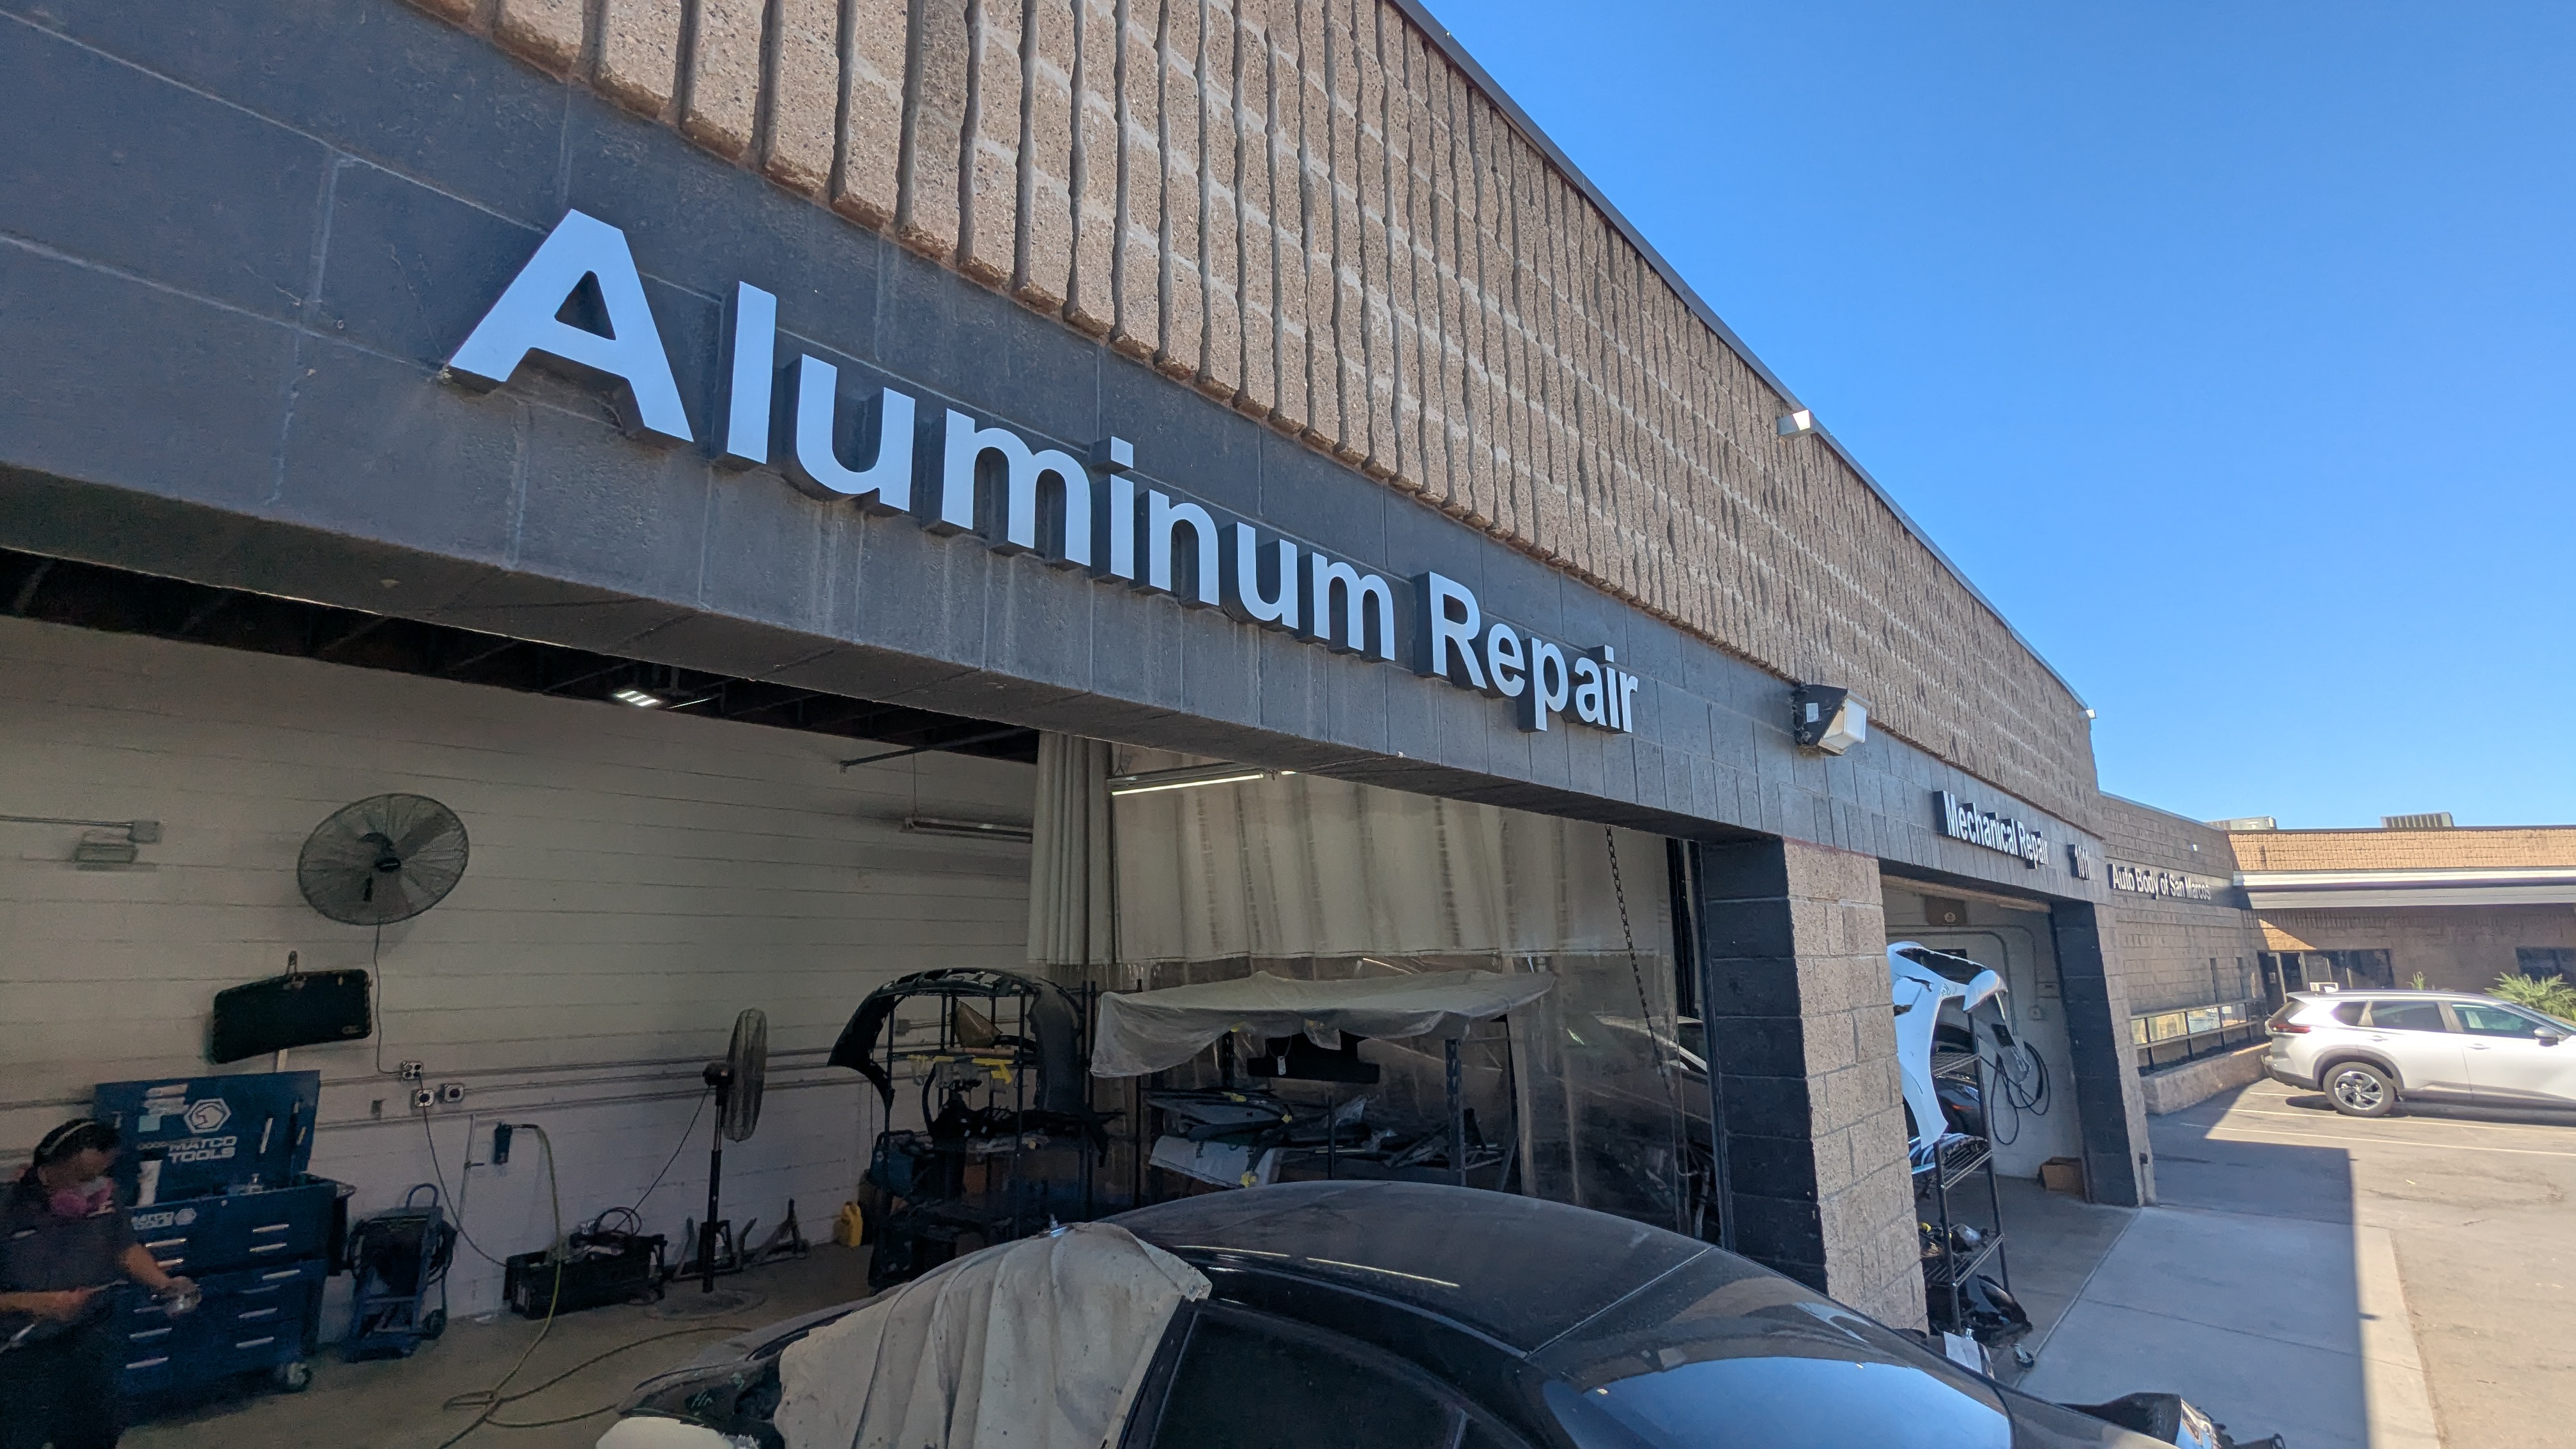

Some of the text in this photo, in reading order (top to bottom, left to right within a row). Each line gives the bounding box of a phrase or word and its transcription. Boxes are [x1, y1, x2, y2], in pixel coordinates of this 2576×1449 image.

[448, 208, 1639, 733] Aluminum Repair
[1943, 790, 2049, 870] Mechanical Repair
[2074, 844, 2091, 880] 1011
[2112, 863, 2211, 900] Auto Body of San Marcos
[167, 1147, 236, 1164] TOOLS
